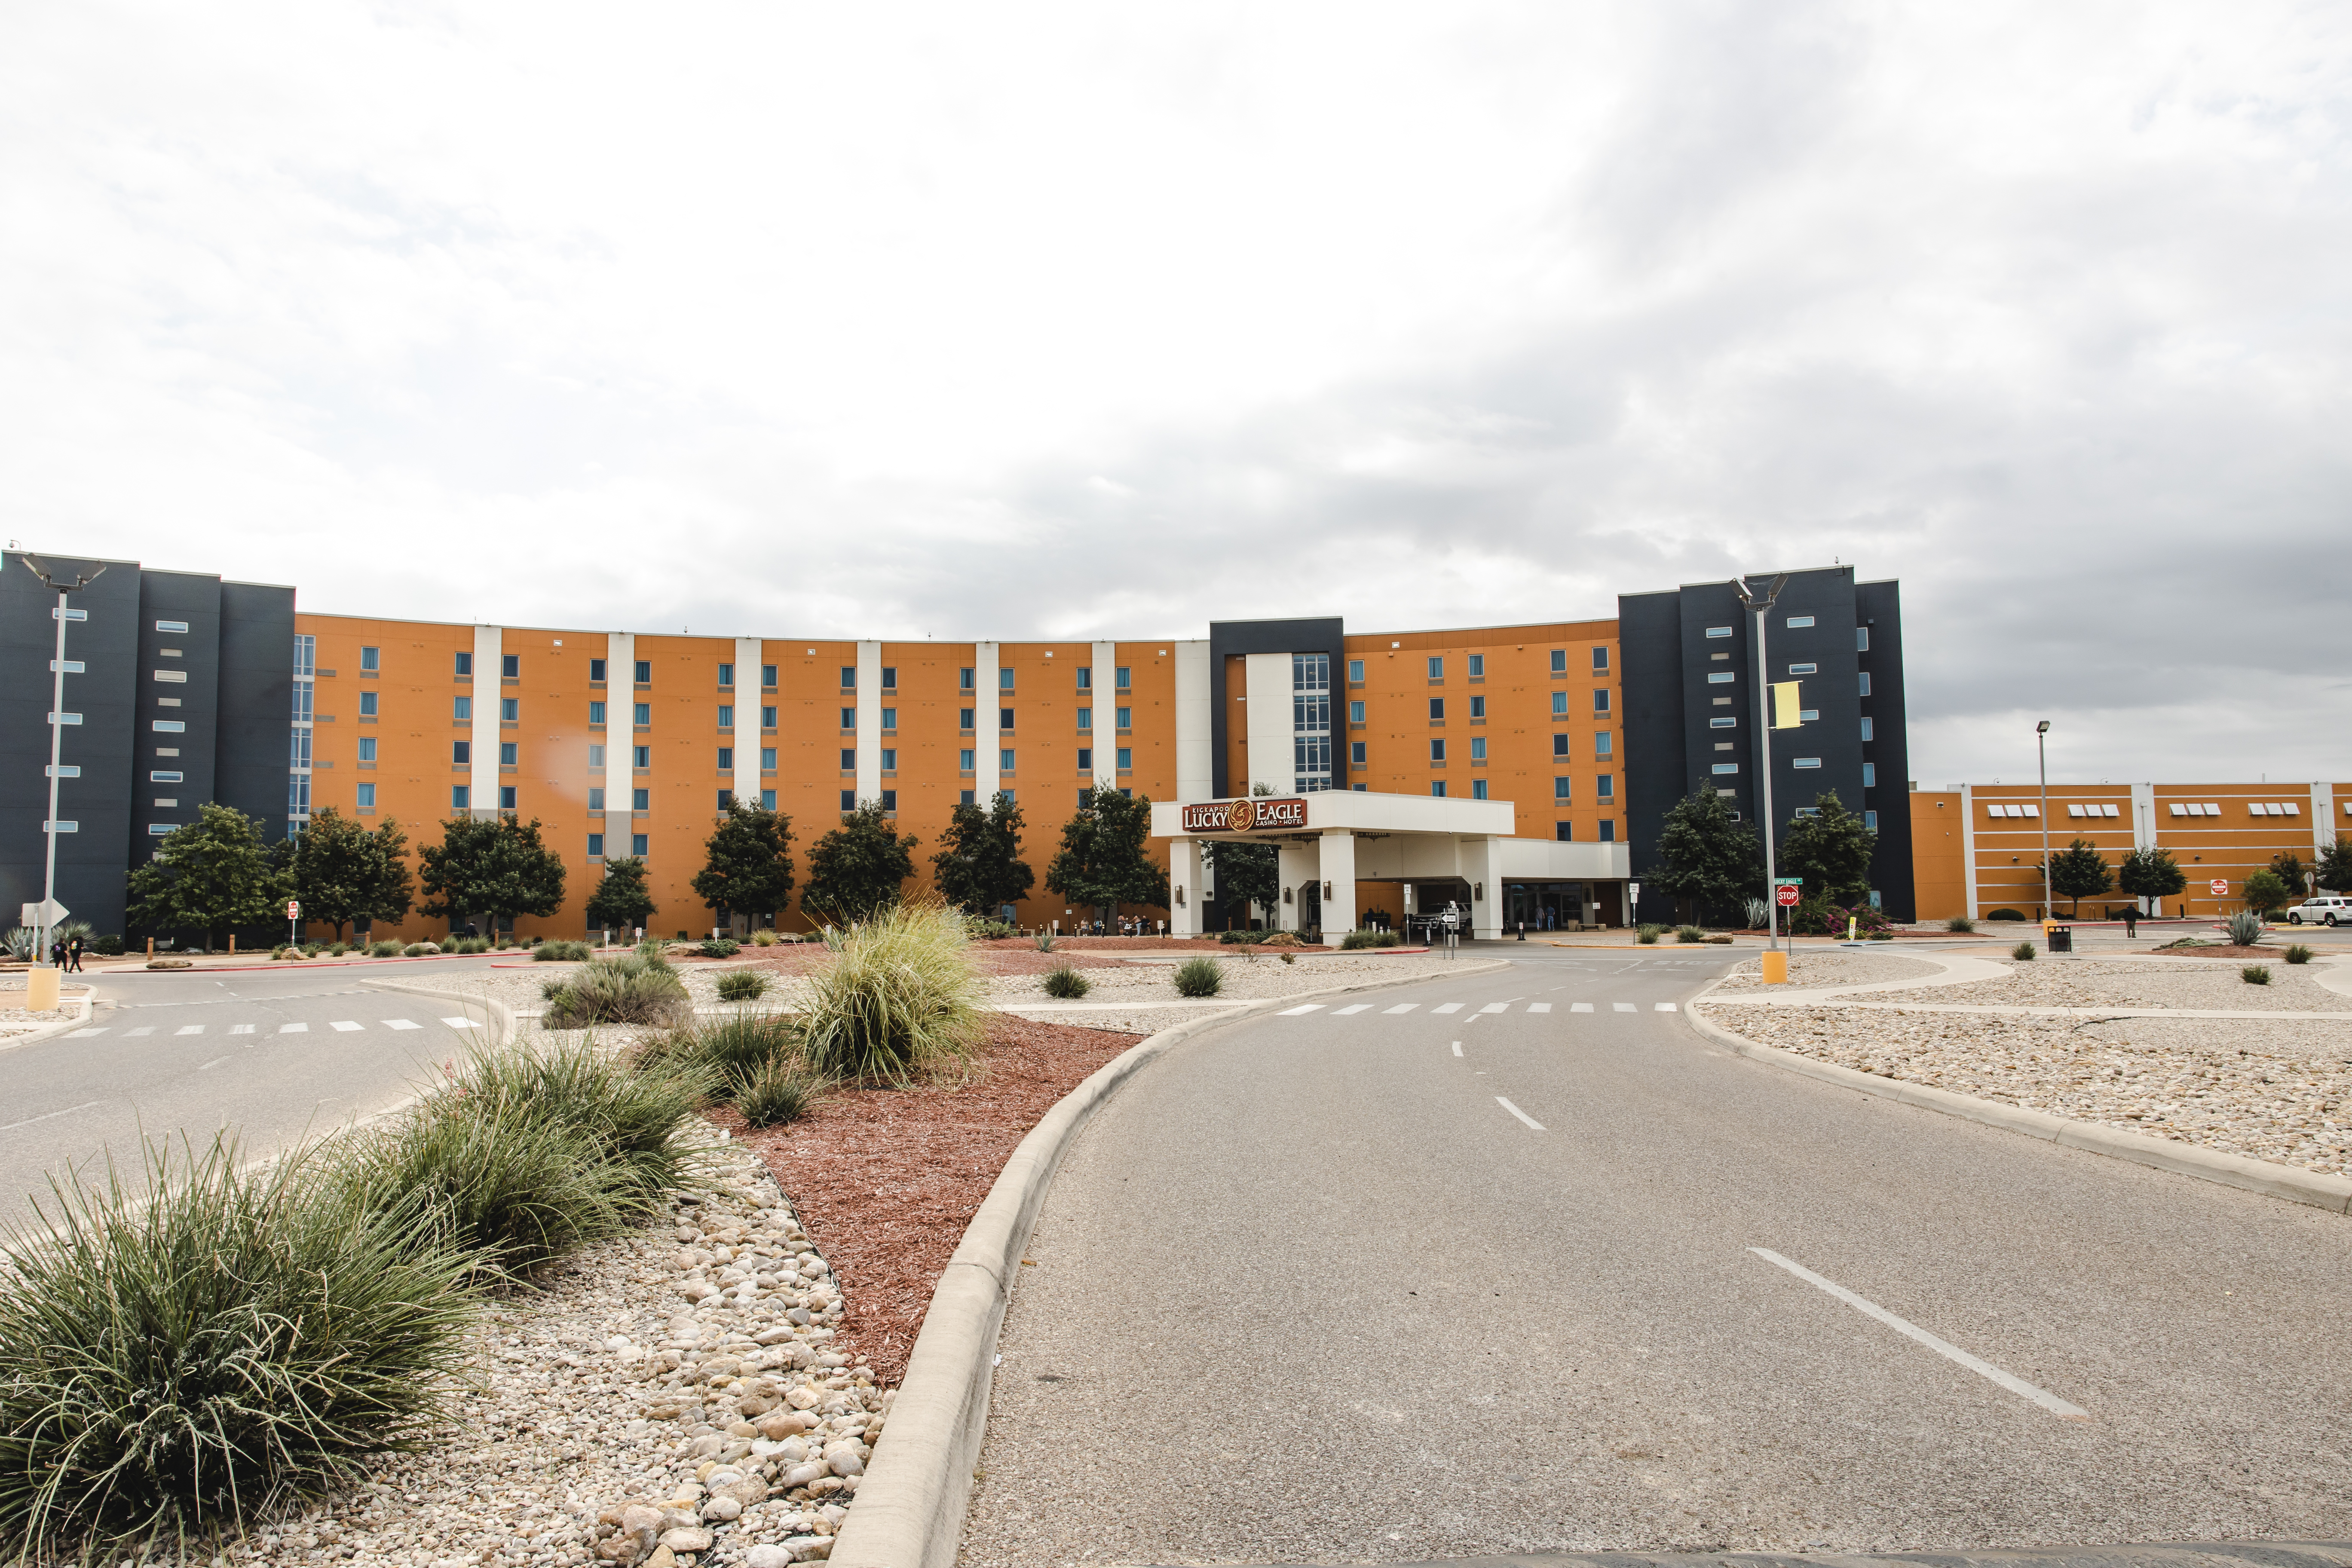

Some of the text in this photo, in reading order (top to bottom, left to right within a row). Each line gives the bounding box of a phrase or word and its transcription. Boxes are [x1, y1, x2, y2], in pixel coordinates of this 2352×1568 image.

[1185, 802, 1302, 828] LUCKY EAGLE
[1778, 891, 1797, 900] STOP
